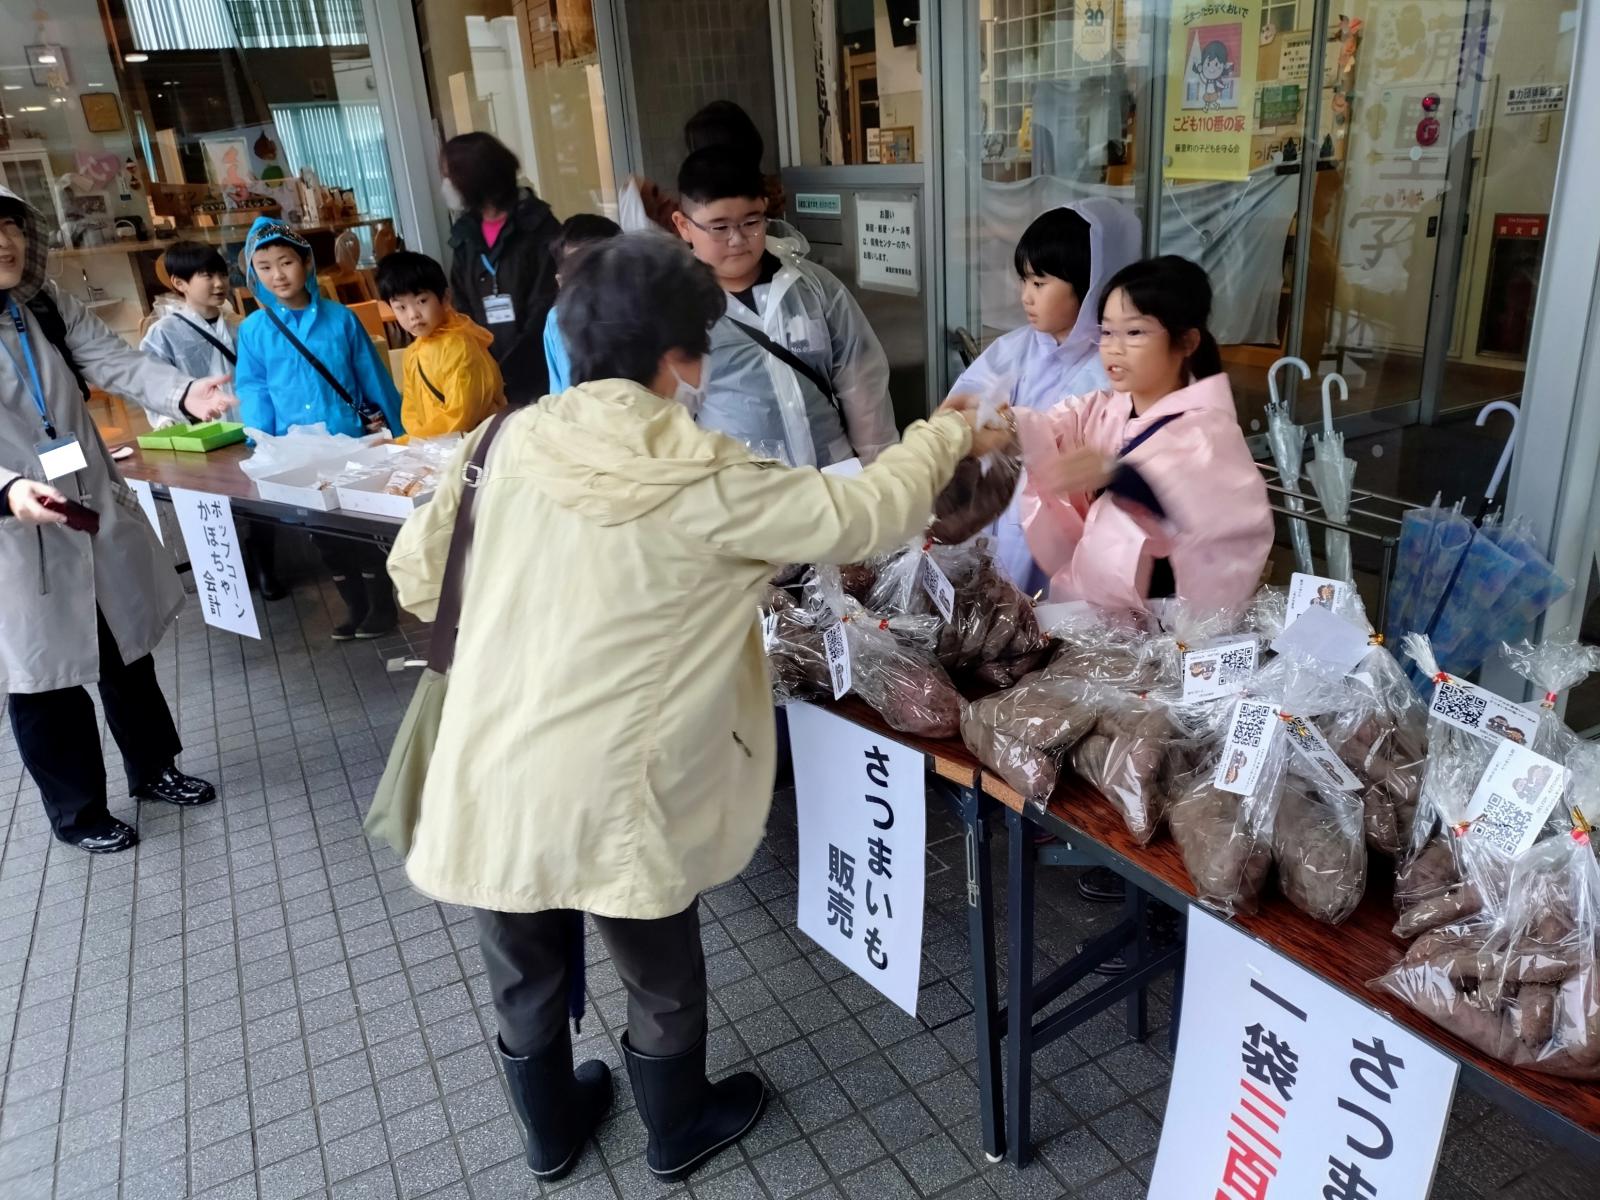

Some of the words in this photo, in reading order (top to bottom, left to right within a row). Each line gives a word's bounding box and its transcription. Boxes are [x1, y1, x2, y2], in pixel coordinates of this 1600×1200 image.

[1173, 115, 1245, 132] こども110番の家
[203, 570, 222, 617] 会計
[827, 843, 856, 940] 販売
[863, 745, 895, 971] さつまいも
[1215, 978, 1307, 1200] 一袋三百
